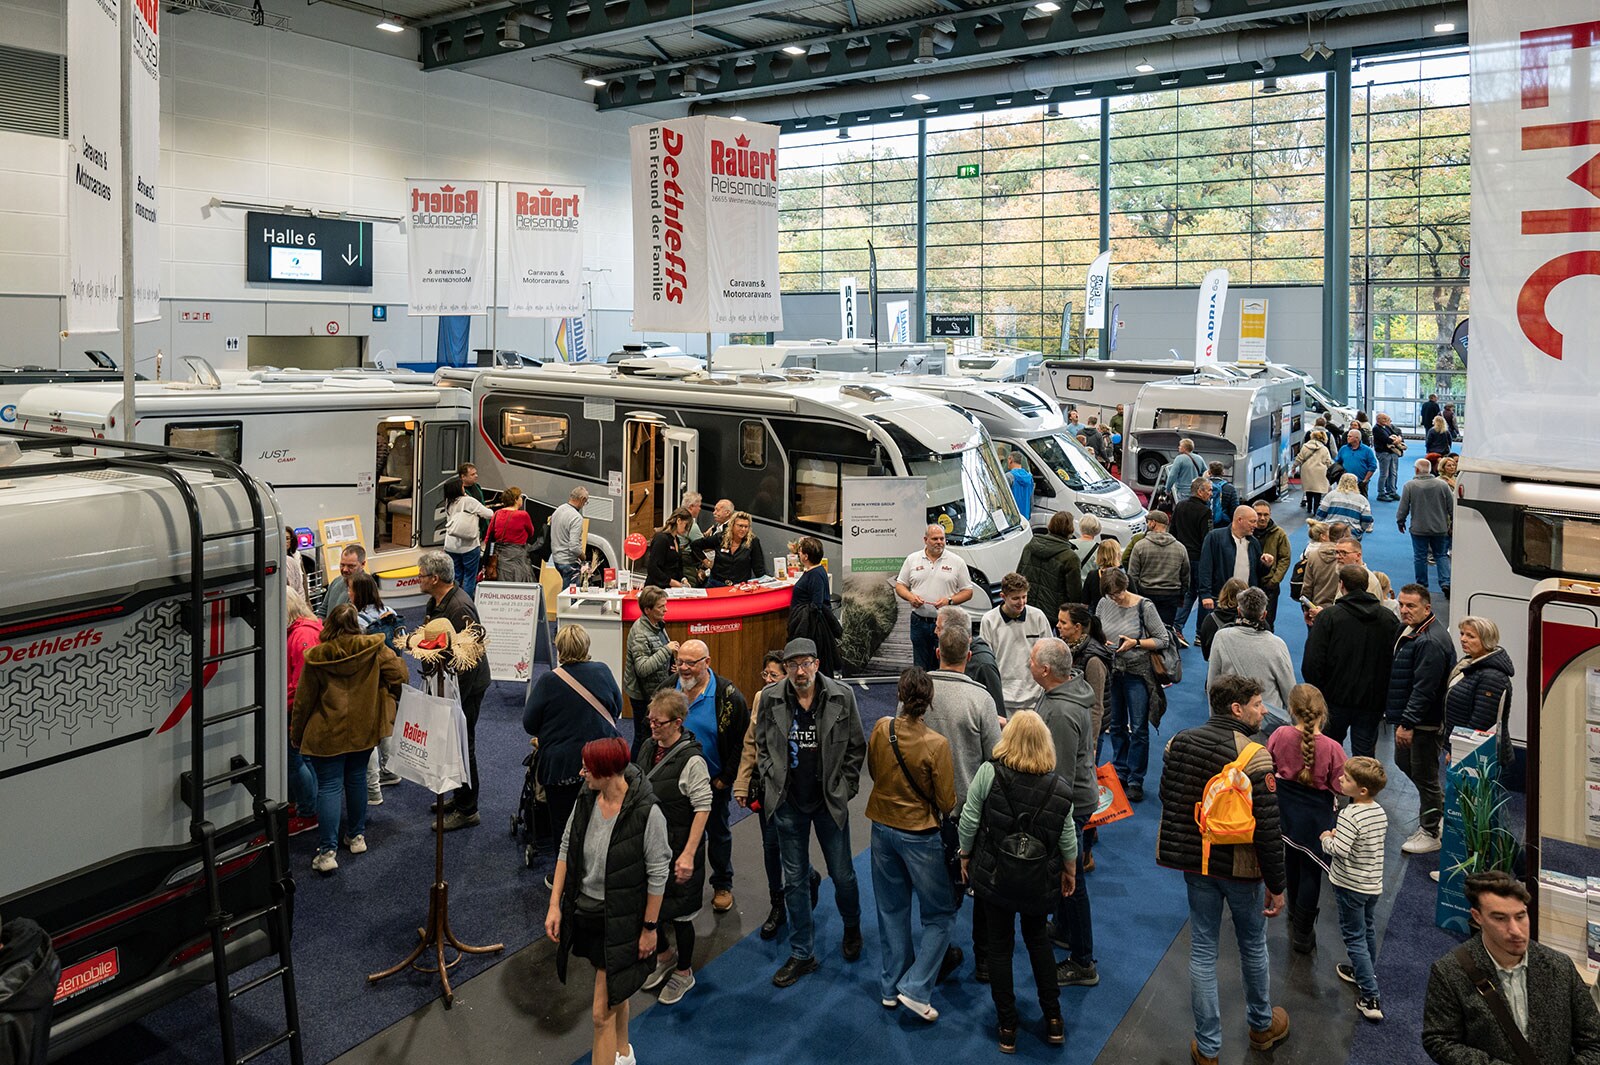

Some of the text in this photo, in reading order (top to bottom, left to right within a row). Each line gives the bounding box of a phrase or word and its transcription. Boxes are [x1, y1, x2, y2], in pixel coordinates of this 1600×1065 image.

[711, 139, 777, 182] Rauert
[711, 176, 777, 199] Reisemobile
[516, 191, 580, 218] Rauert
[711, 195, 728, 203] 26655
[516, 214, 579, 229] Reisemobile
[649, 127, 664, 301] Ein Freund der Familie
[662, 127, 688, 305] Dethleffs
[263, 228, 316, 246] Halle 6
[522, 277, 570, 285] Motorcaravans
[527, 269, 559, 277] Caravans
[729, 278, 766, 288] Caravans &
[722, 289, 772, 299] Motorcaravans
[1207, 293, 1217, 341] ADRIA
[258, 449, 290, 460] JUST
[573, 450, 596, 459] ALPA
[480, 592, 535, 601] FRÜHLINGSMESSE
[0, 628, 103, 665] Dethleffs
[403, 721, 428, 746] Rauert
[1446, 808, 1462, 817] Cam
[56, 961, 113, 995] semobile
